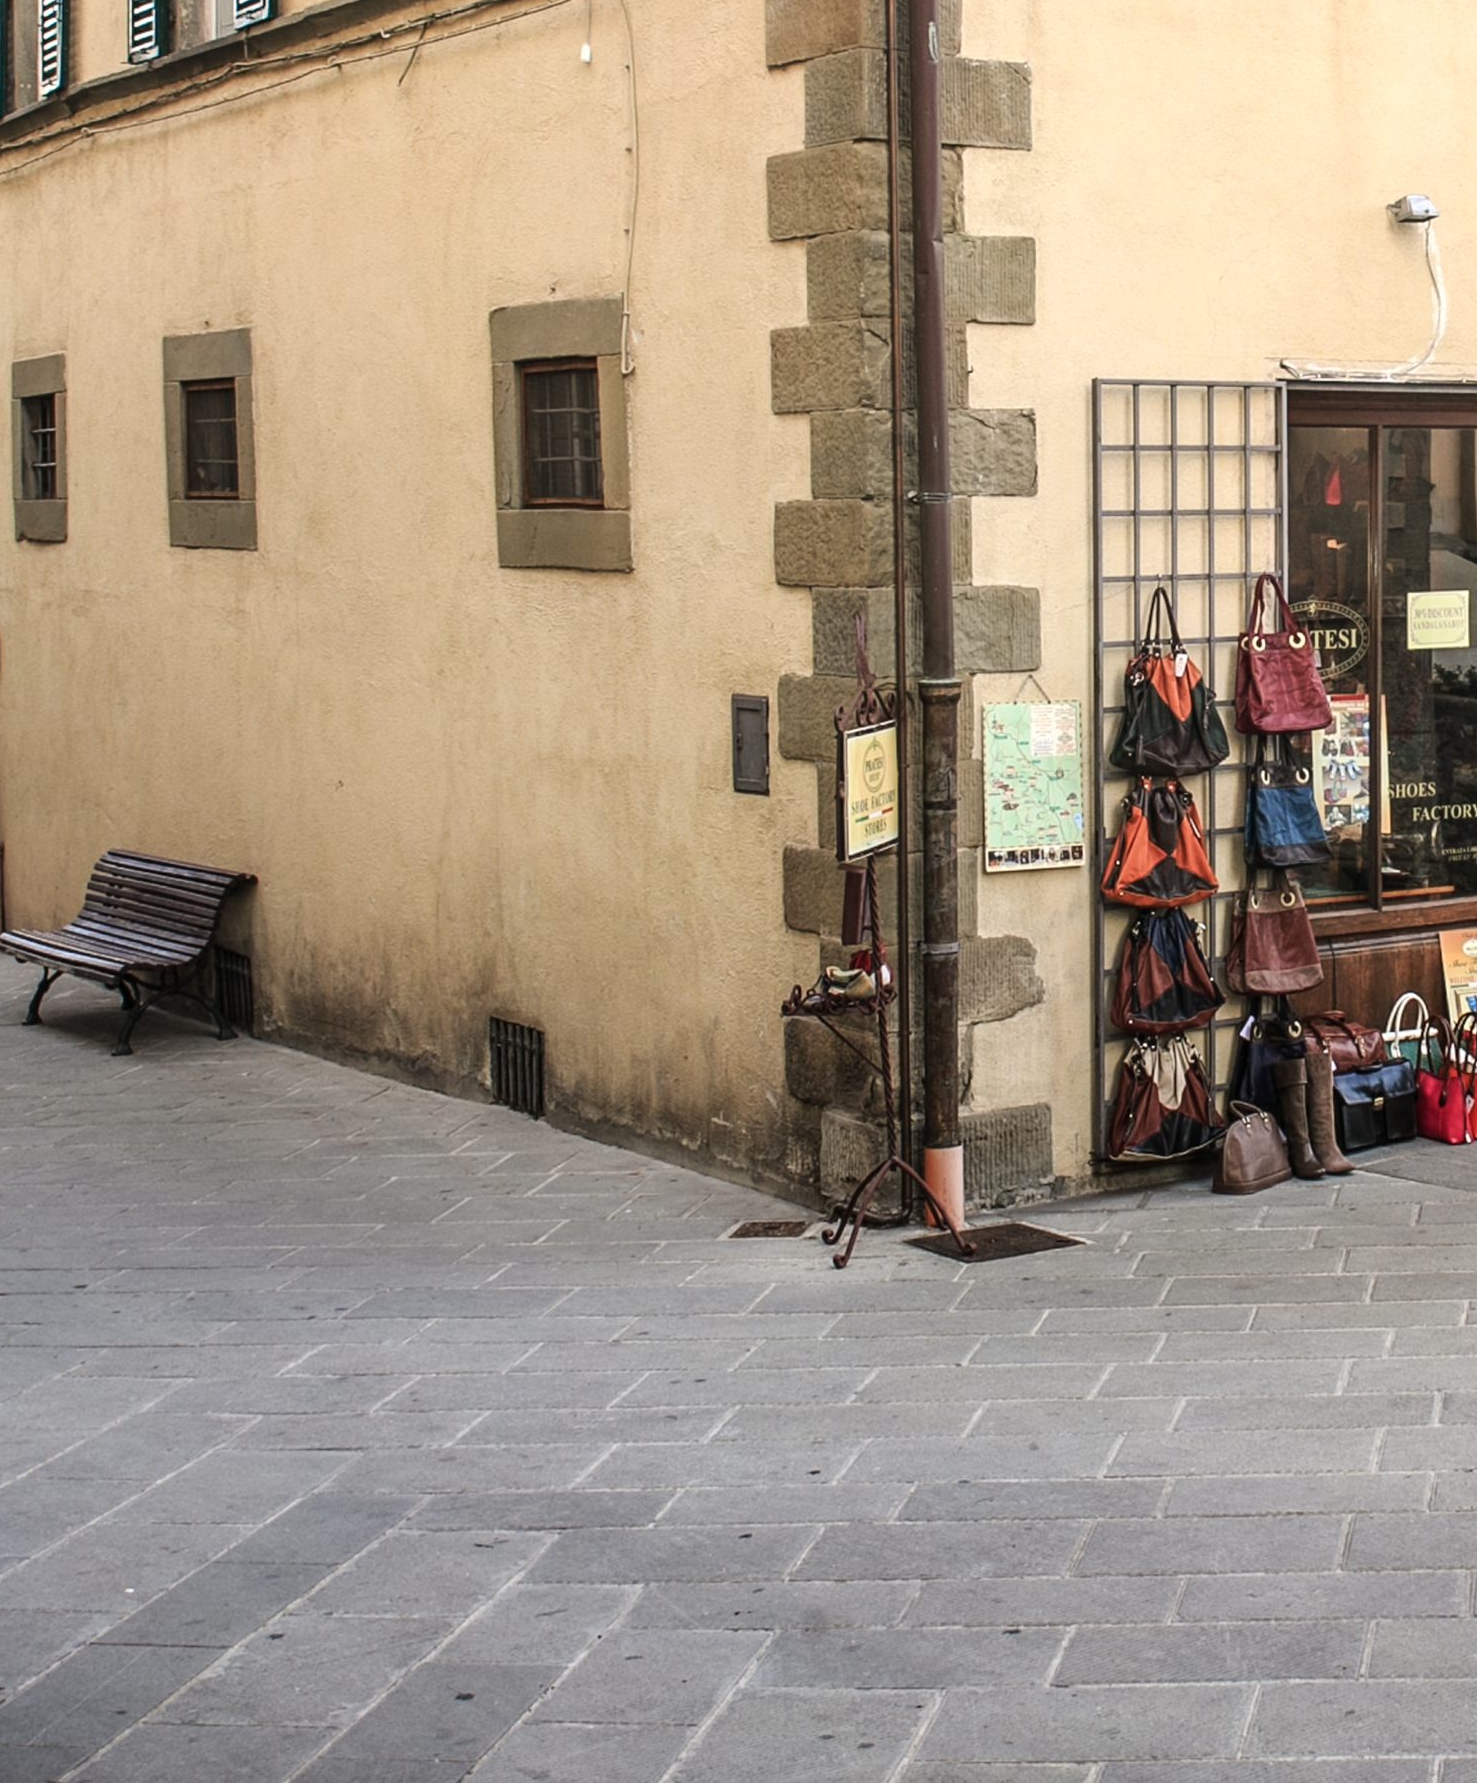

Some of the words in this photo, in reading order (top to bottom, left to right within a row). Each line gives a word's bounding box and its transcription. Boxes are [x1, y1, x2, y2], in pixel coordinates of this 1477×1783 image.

[1428, 607, 1463, 619] DISCOUNT
[1310, 628, 1358, 650] TESI
[1388, 782, 1436, 798] SHOES
[851, 797, 869, 815] SHOE
[871, 788, 896, 811] FACTORY
[865, 817, 887, 837] STORES
